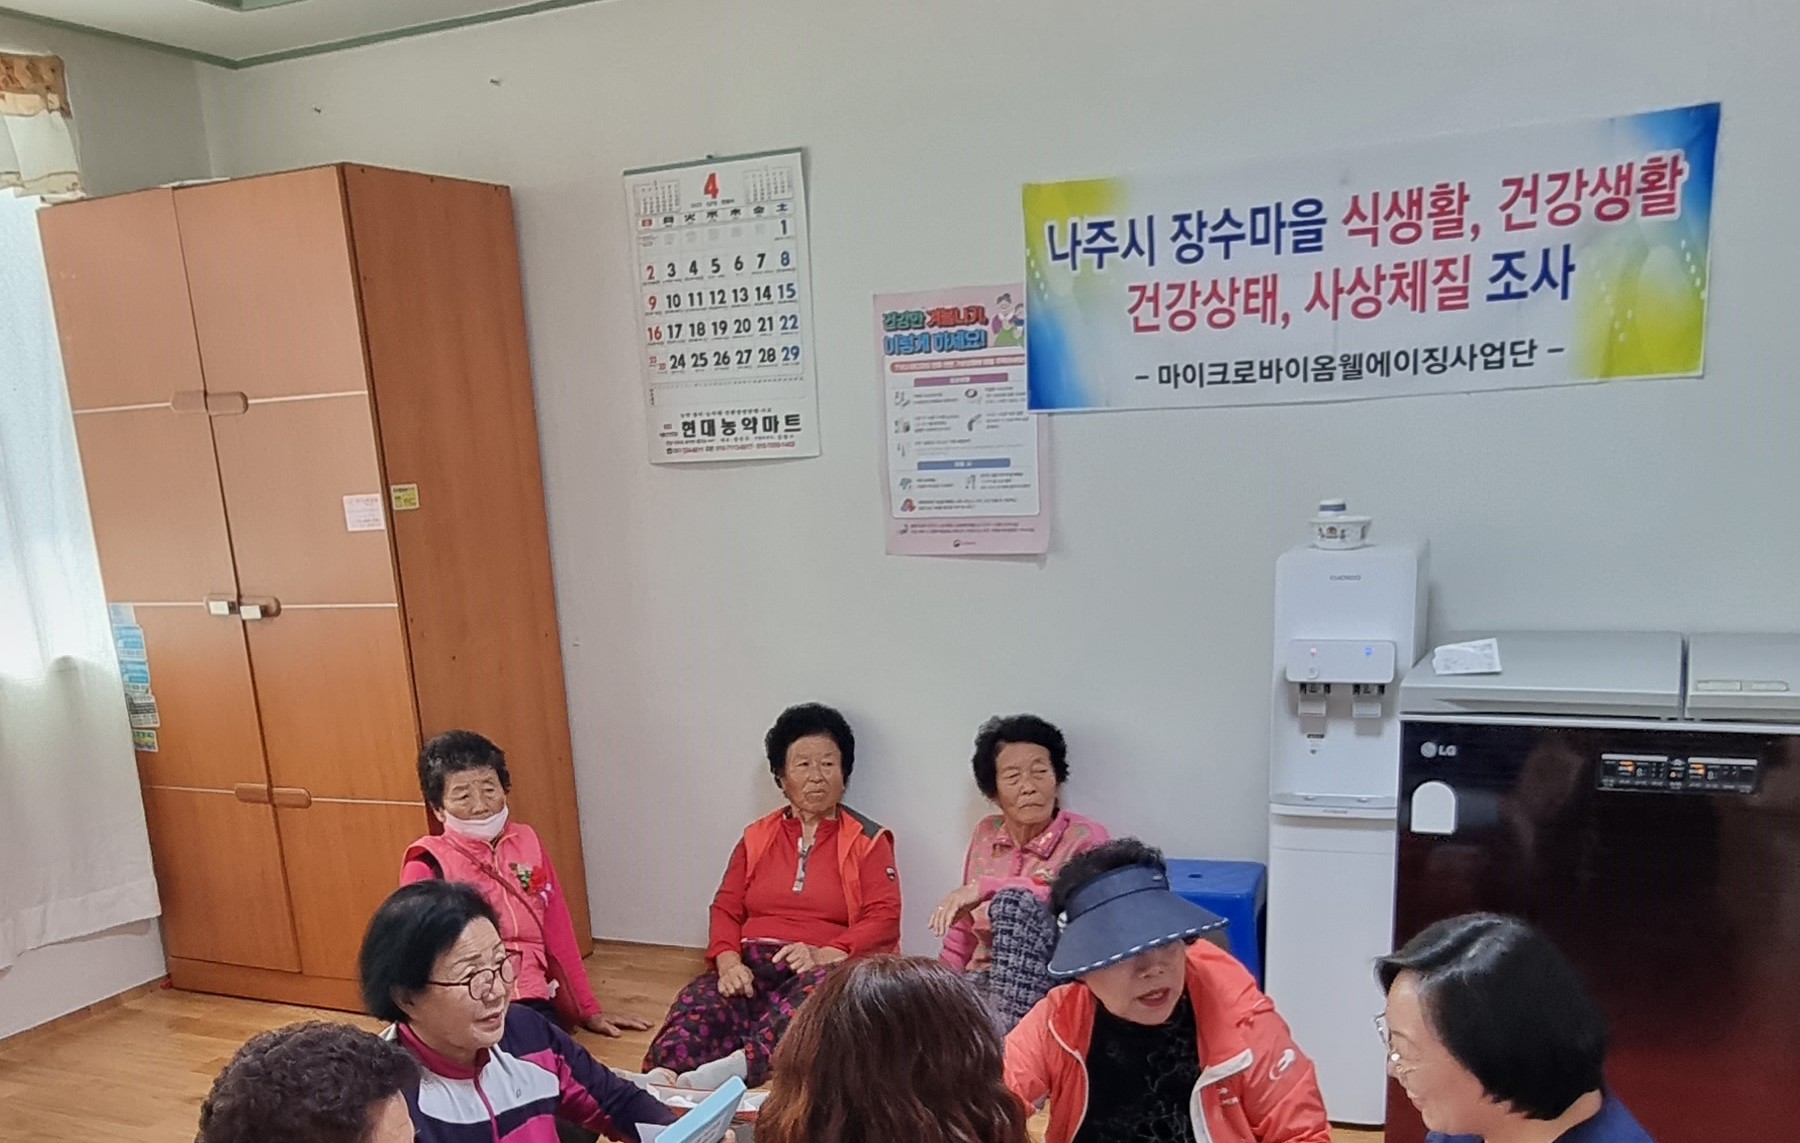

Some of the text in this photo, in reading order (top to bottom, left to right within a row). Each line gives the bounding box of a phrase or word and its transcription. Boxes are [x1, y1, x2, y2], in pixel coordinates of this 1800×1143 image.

[704, 172, 719, 200] 4
[1046, 153, 1687, 271] 나주시 장수마을 식생활, 건강생활
[780, 219, 788, 235] 1
[646, 250, 790, 280] 2 3 4 5 6 7 8
[648, 283, 796, 311] 9 10 11 12 13 14 15
[1125, 244, 1576, 334] 건강상태, 사상체질 조사
[647, 314, 799, 341] 16 17 18 19 20 21 22
[670, 353, 686, 369] 24
[691, 352, 708, 368] 25
[713, 350, 731, 367] 26
[735, 349, 752, 365] 27
[758, 347, 776, 363] 28
[781, 345, 800, 362] 29
[1157, 338, 1538, 389] 마이크로바이옴웰에이징사업단
[681, 413, 802, 439] 현대농약마트
[1438, 745, 1457, 756] LG
